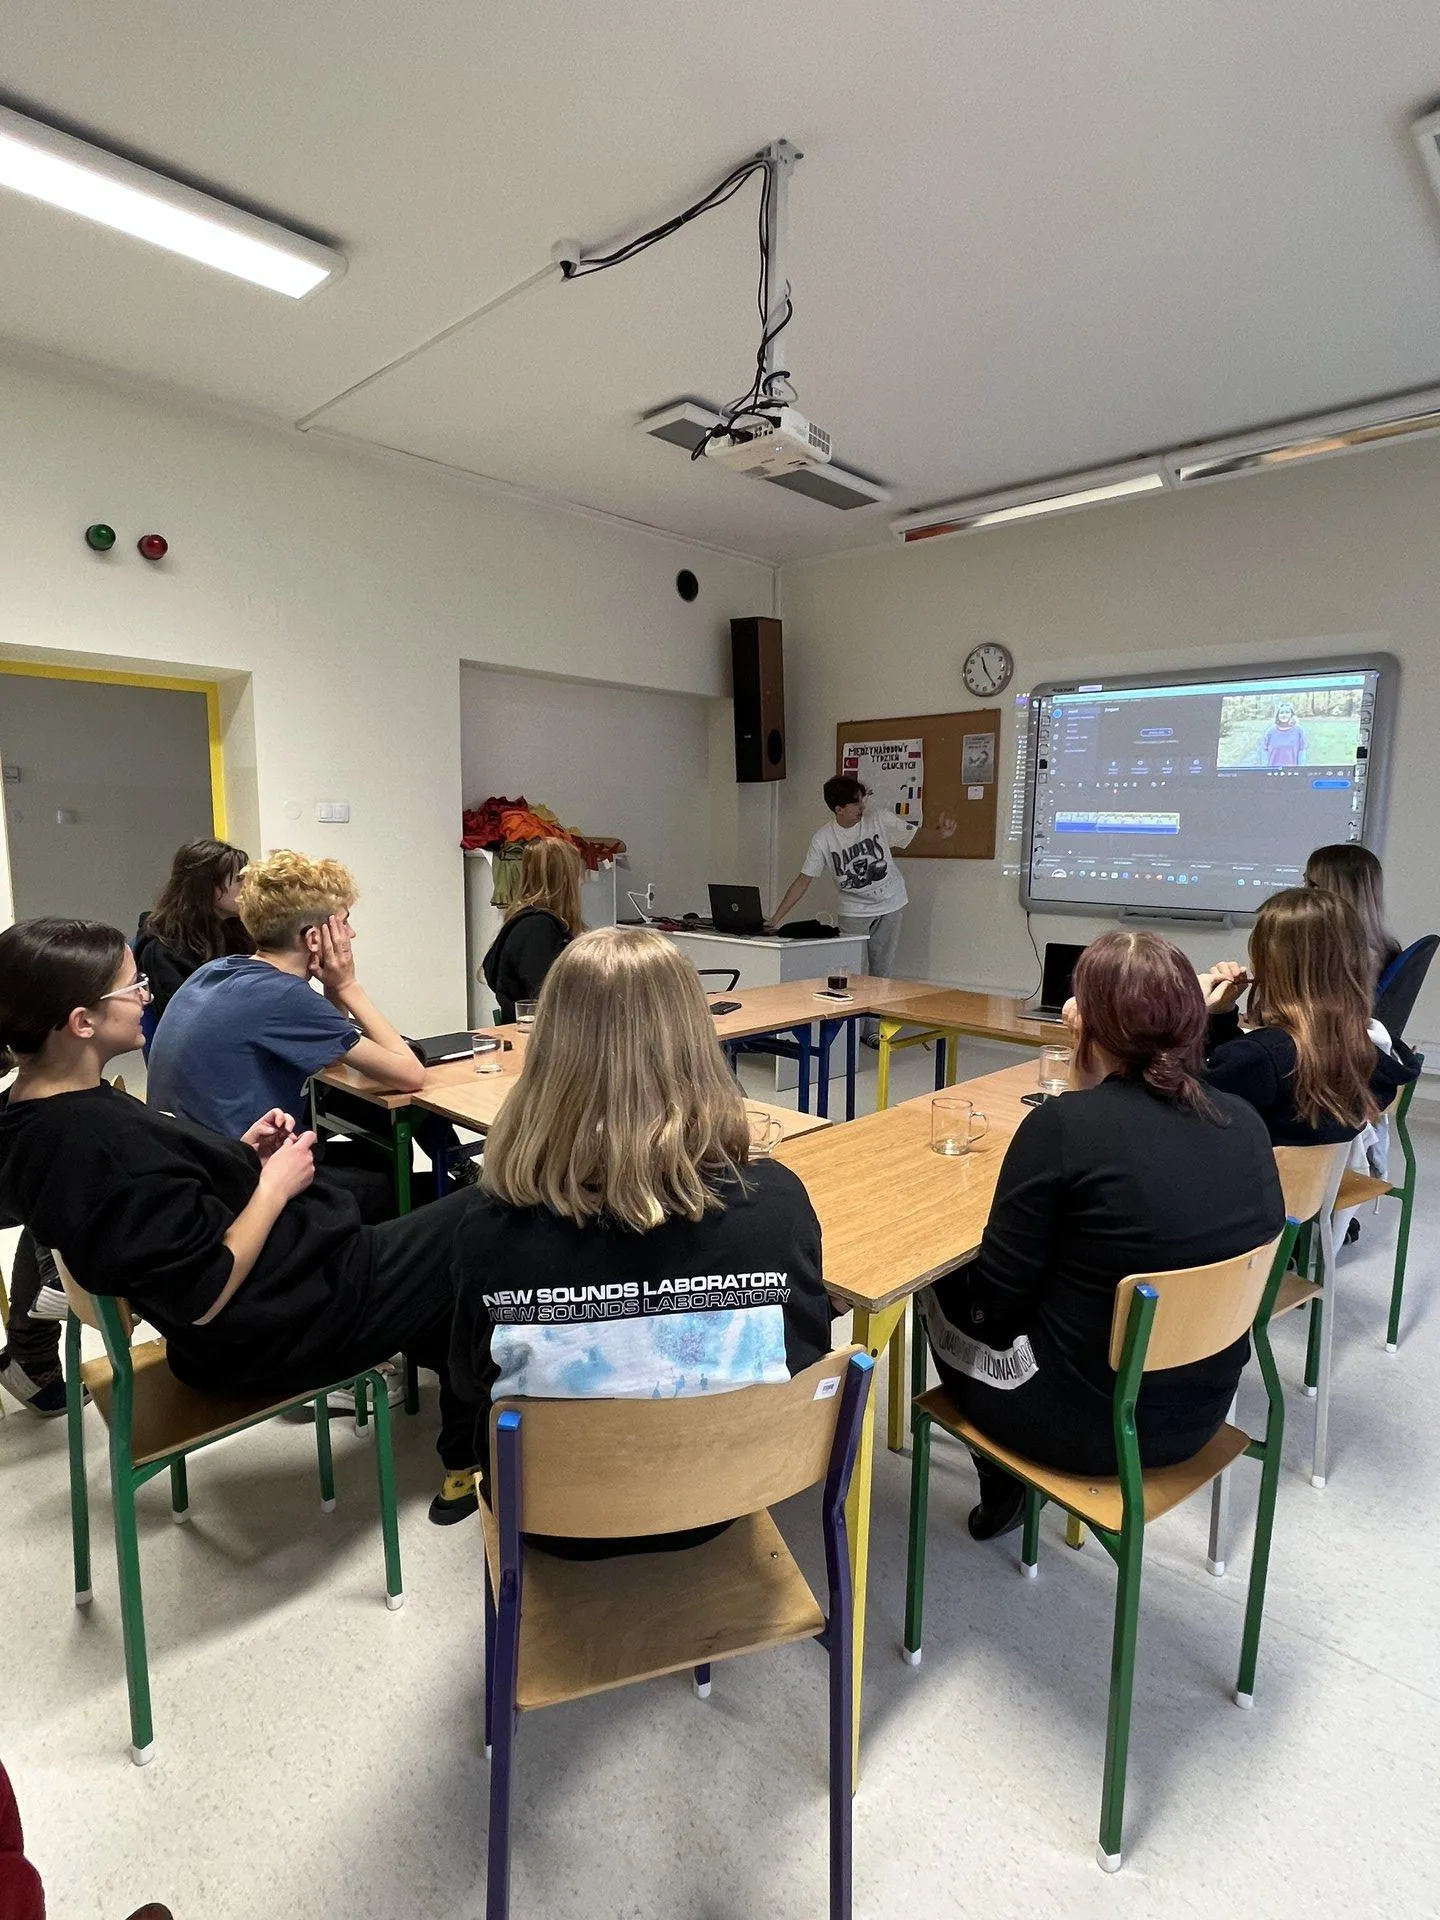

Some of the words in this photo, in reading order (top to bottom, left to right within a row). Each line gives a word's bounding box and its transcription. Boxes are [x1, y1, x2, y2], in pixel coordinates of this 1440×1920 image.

[831, 834, 884, 876] RAIDERS
[482, 1289, 533, 1307] NEW
[536, 1282, 639, 1304] SOUNDS
[643, 1272, 788, 1296] LABORATORY
[487, 1306, 535, 1322] NEW
[538, 1299, 640, 1321] SOUNDS
[643, 1289, 791, 1313] LABORATORY
